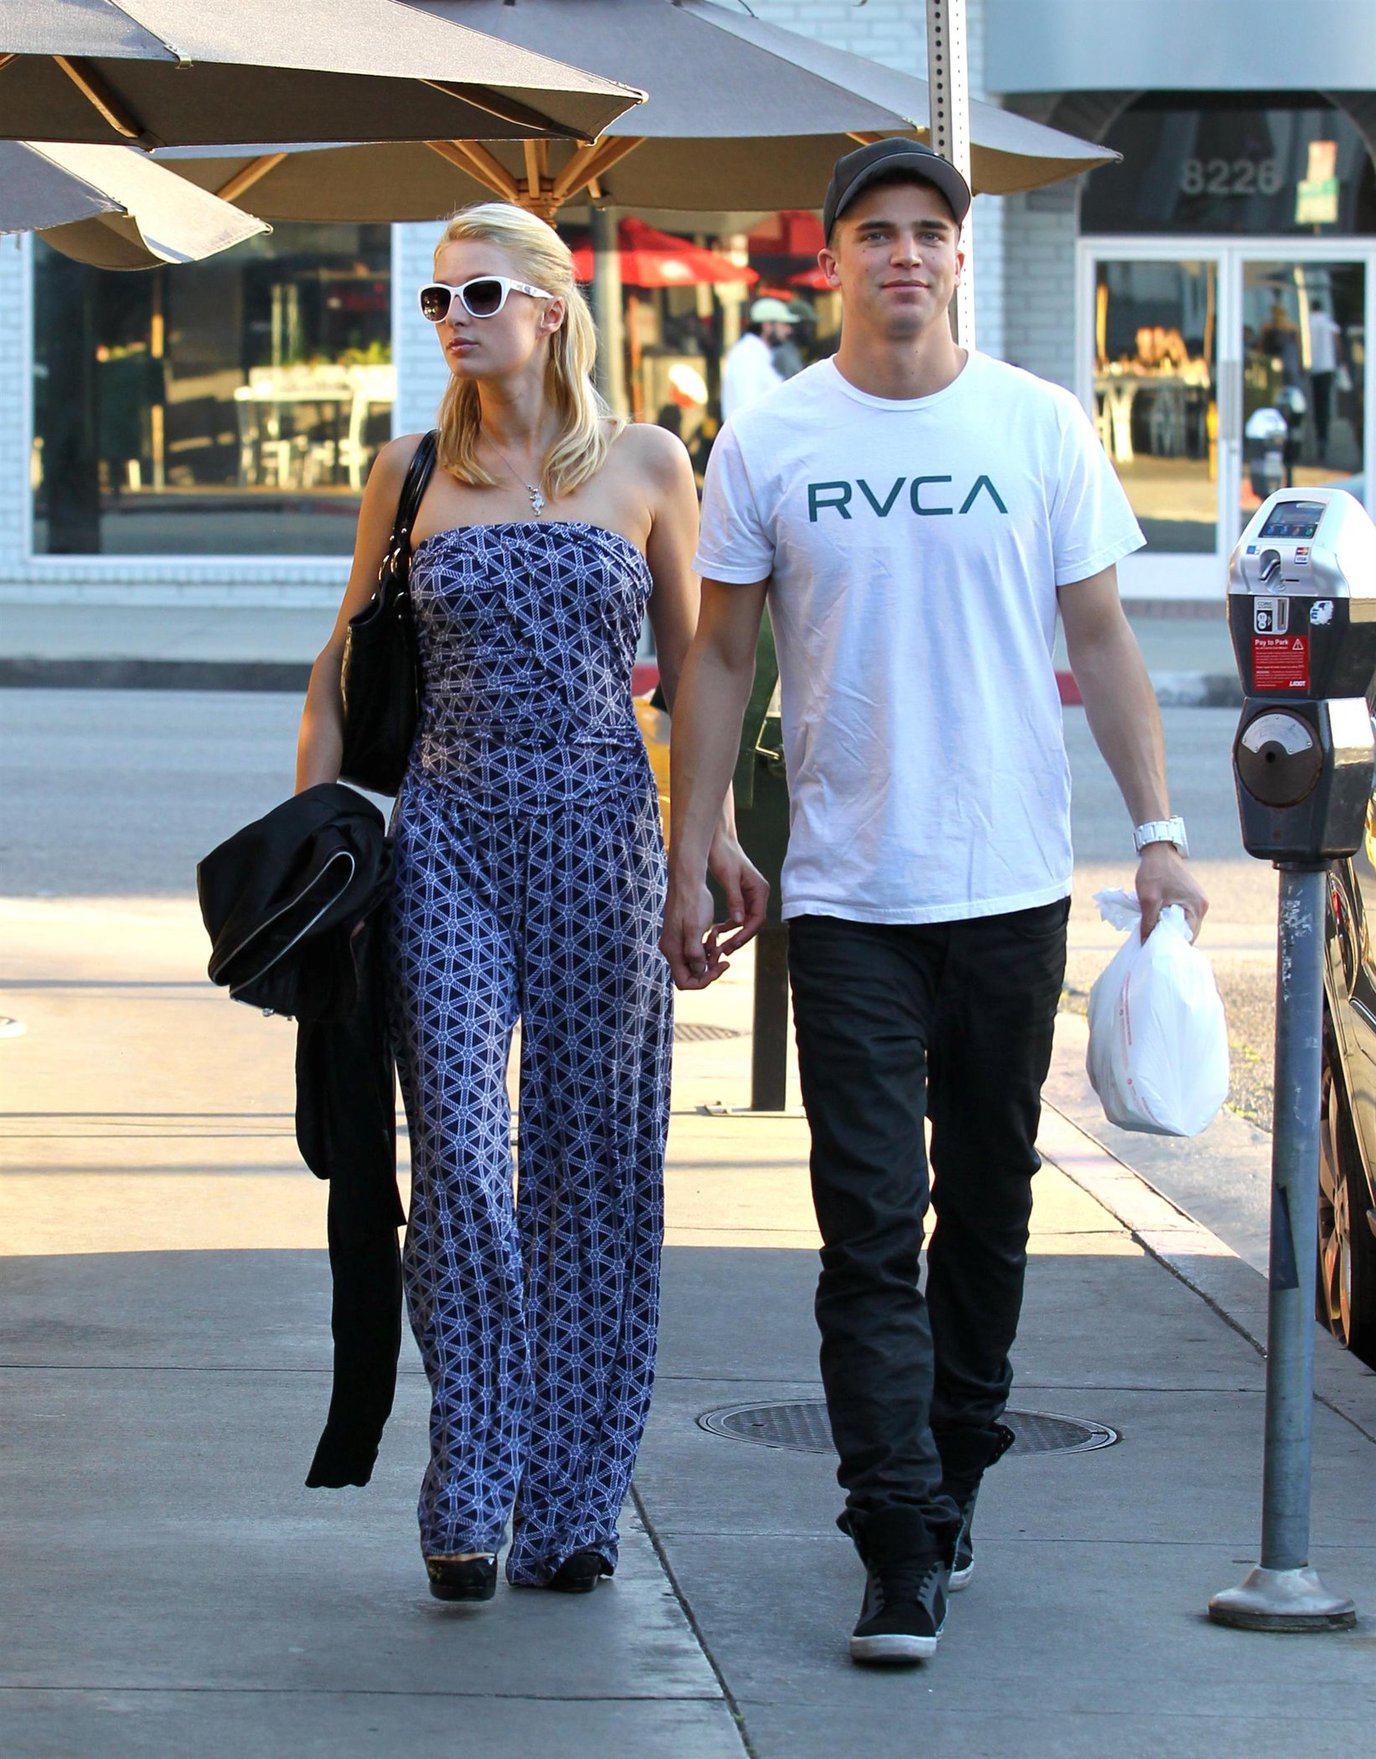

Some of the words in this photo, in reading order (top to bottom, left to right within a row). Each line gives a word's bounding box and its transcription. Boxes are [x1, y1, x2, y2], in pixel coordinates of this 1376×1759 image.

[1183, 159, 1283, 195] 8226
[808, 475, 1009, 522] RVCA
[1255, 639, 1267, 647] Pay
